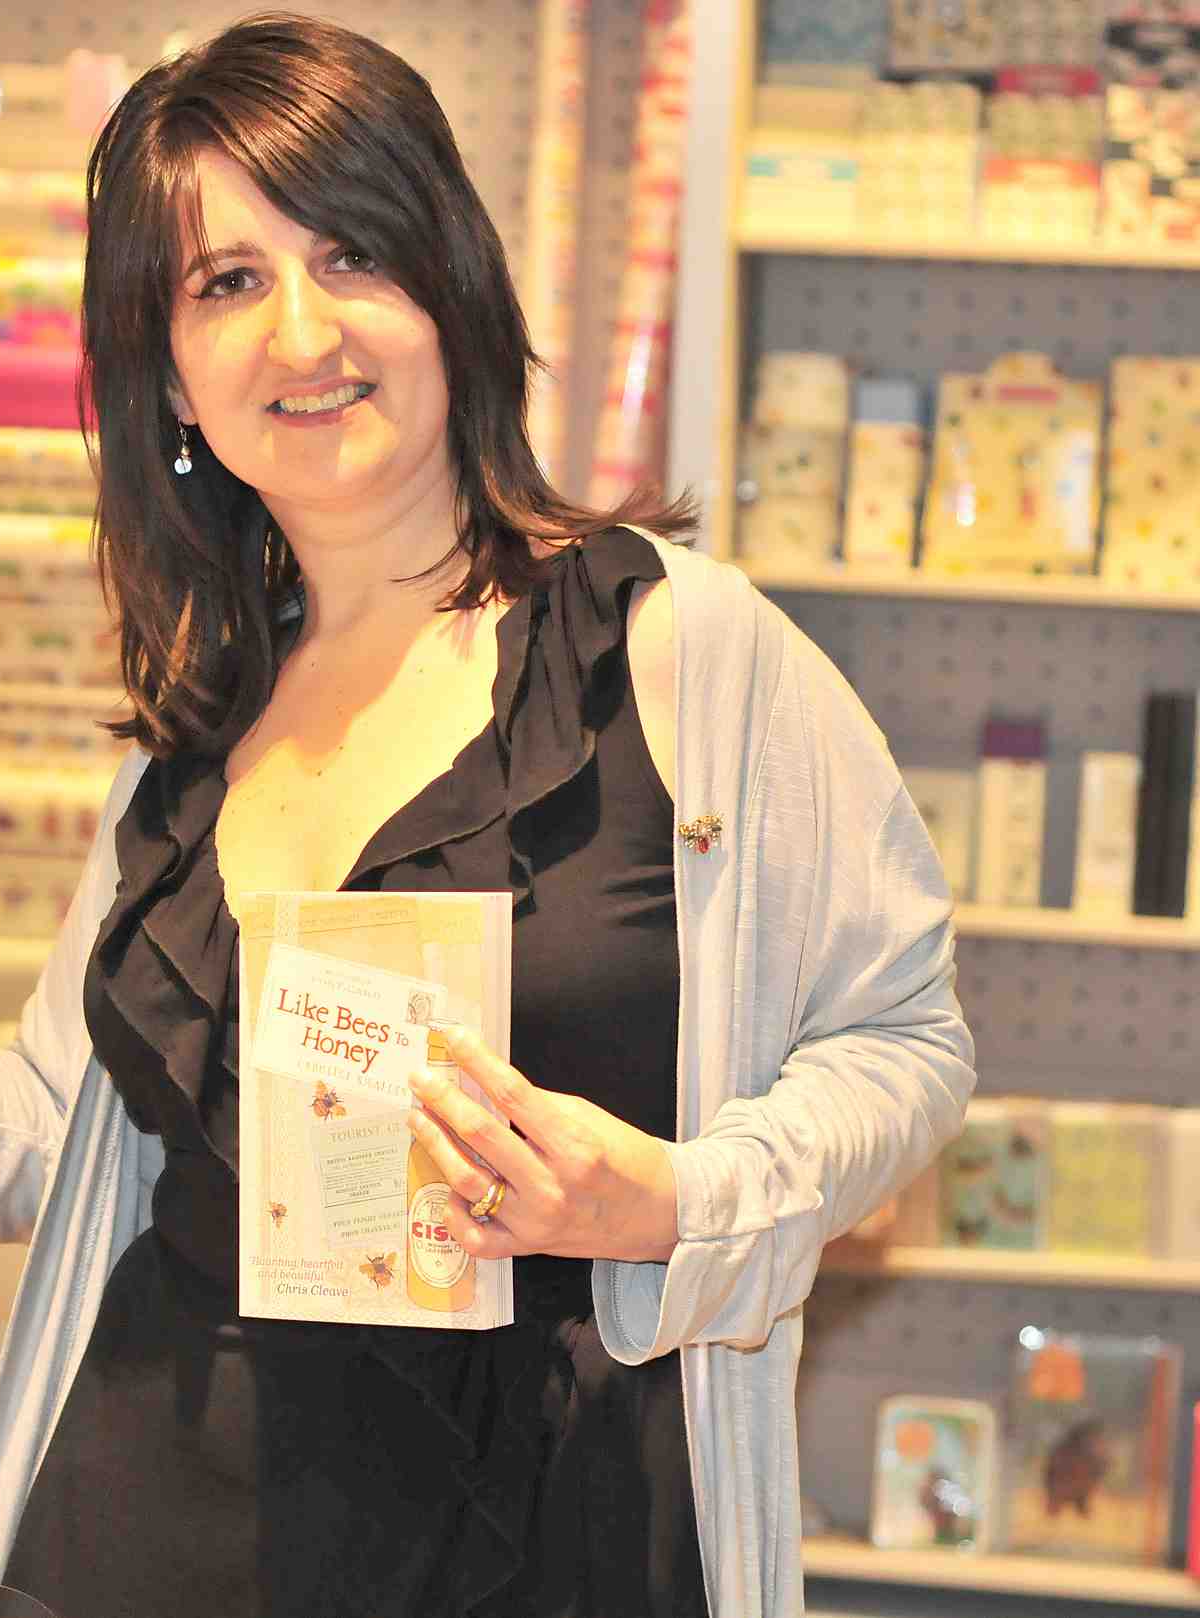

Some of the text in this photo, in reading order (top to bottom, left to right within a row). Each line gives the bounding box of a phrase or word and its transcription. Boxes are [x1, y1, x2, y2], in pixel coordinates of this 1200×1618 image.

[276, 988, 409, 1047] Like Bees To
[301, 1026, 380, 1074] Honey
[412, 1222, 456, 1242] CIS
[277, 1283, 350, 1297] Chris Cleave
